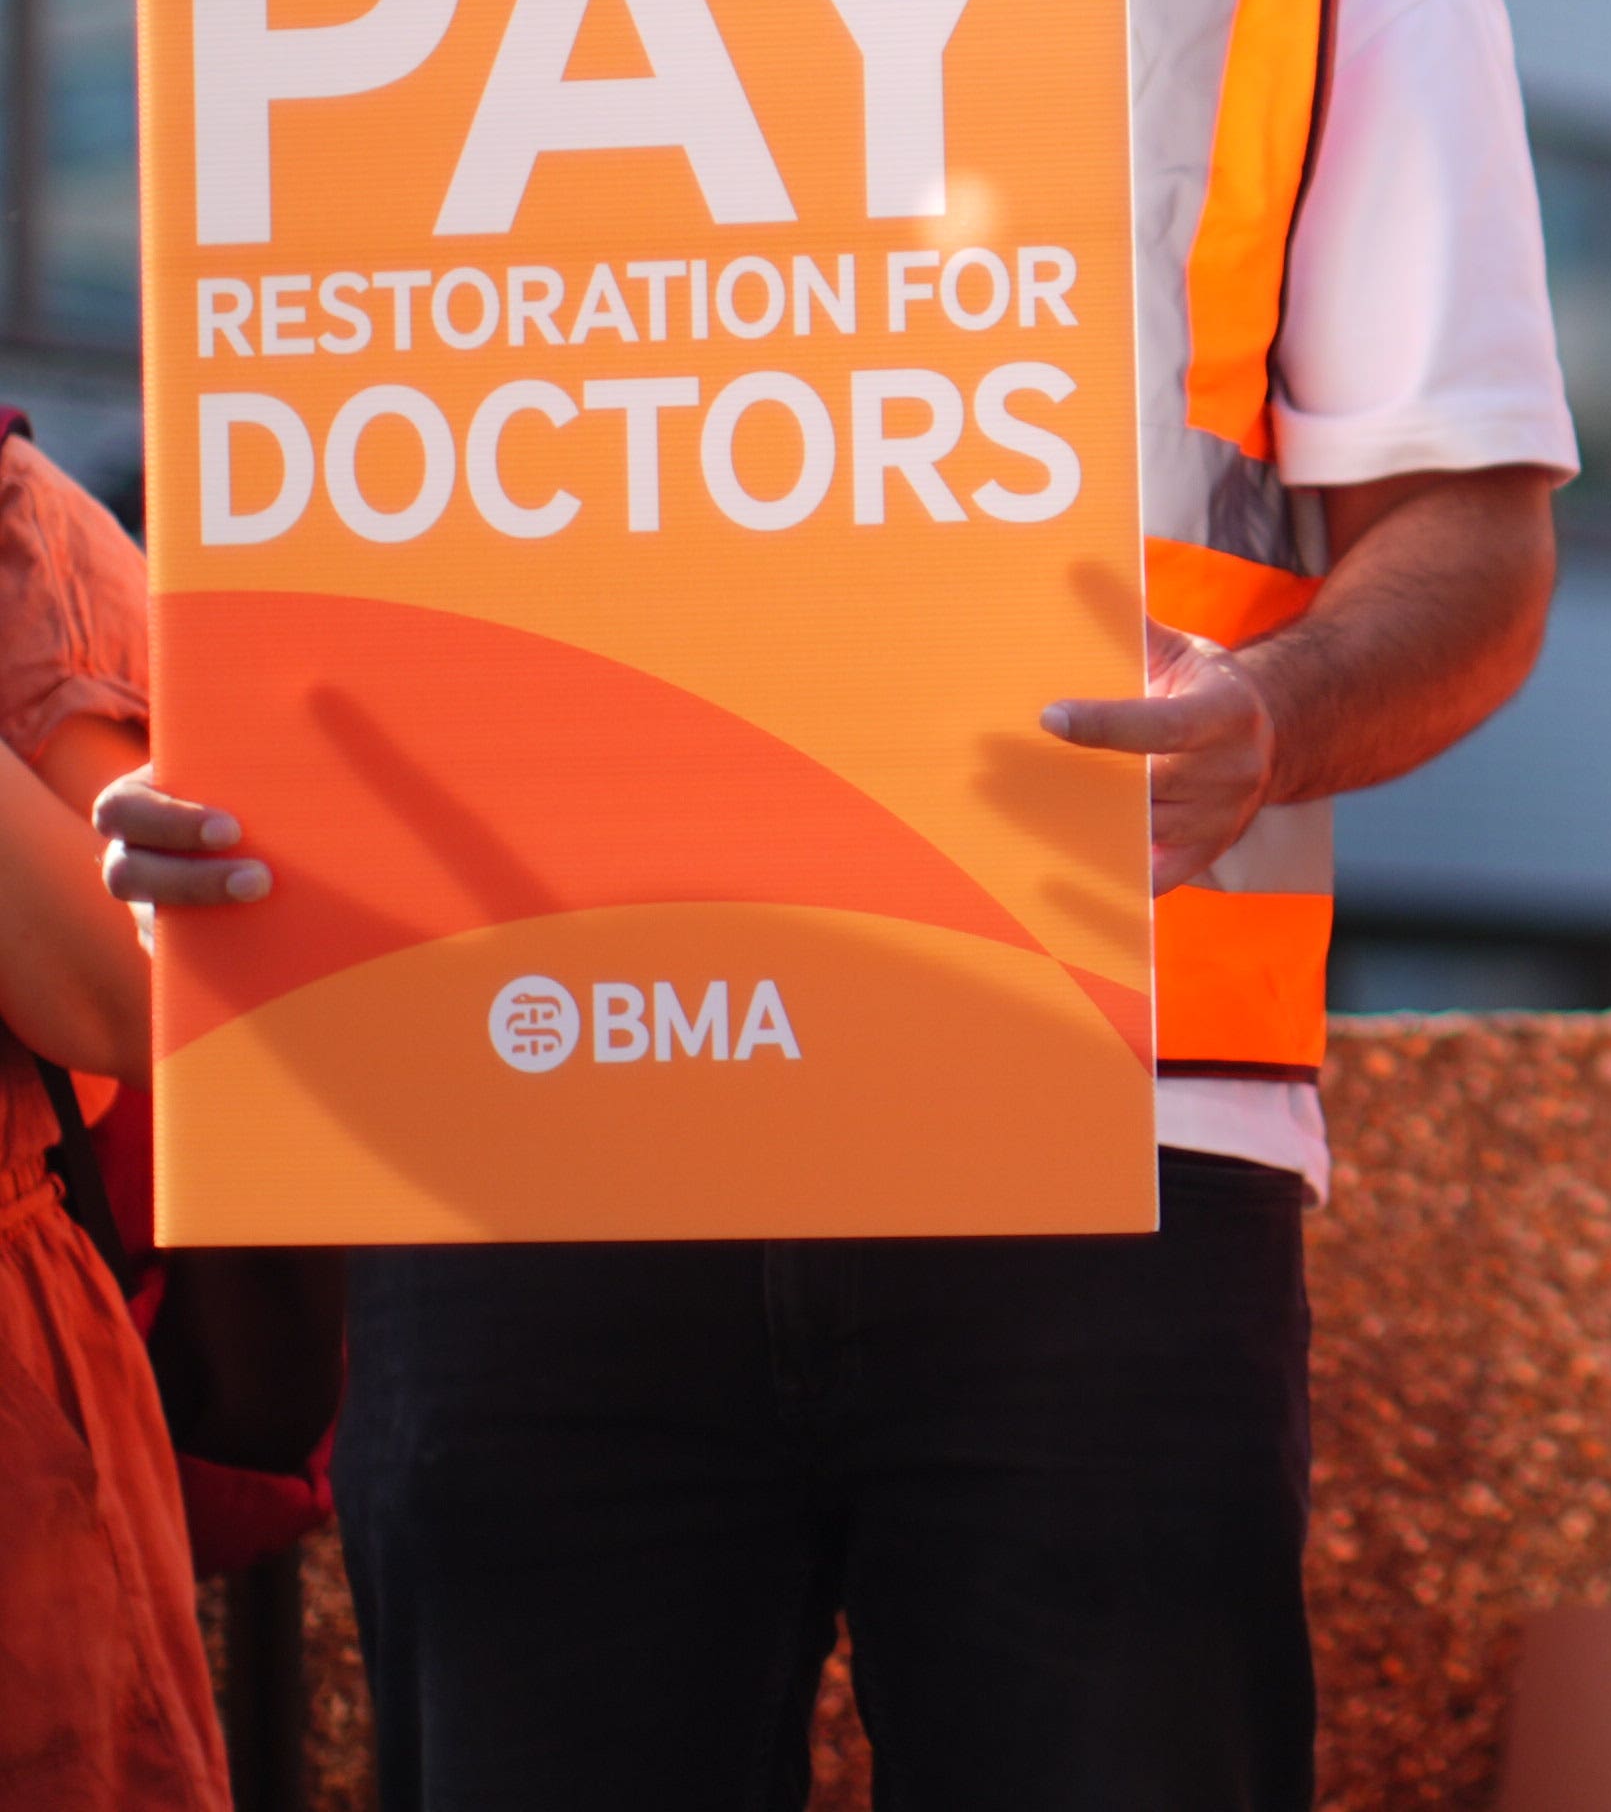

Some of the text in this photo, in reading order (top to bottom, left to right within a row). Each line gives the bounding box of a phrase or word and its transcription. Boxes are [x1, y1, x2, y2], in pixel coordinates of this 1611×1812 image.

[197, 245, 1079, 358] RESTORATION FOR
[200, 361, 1082, 546] DOCTORS
[592, 979, 801, 1062] BMA
